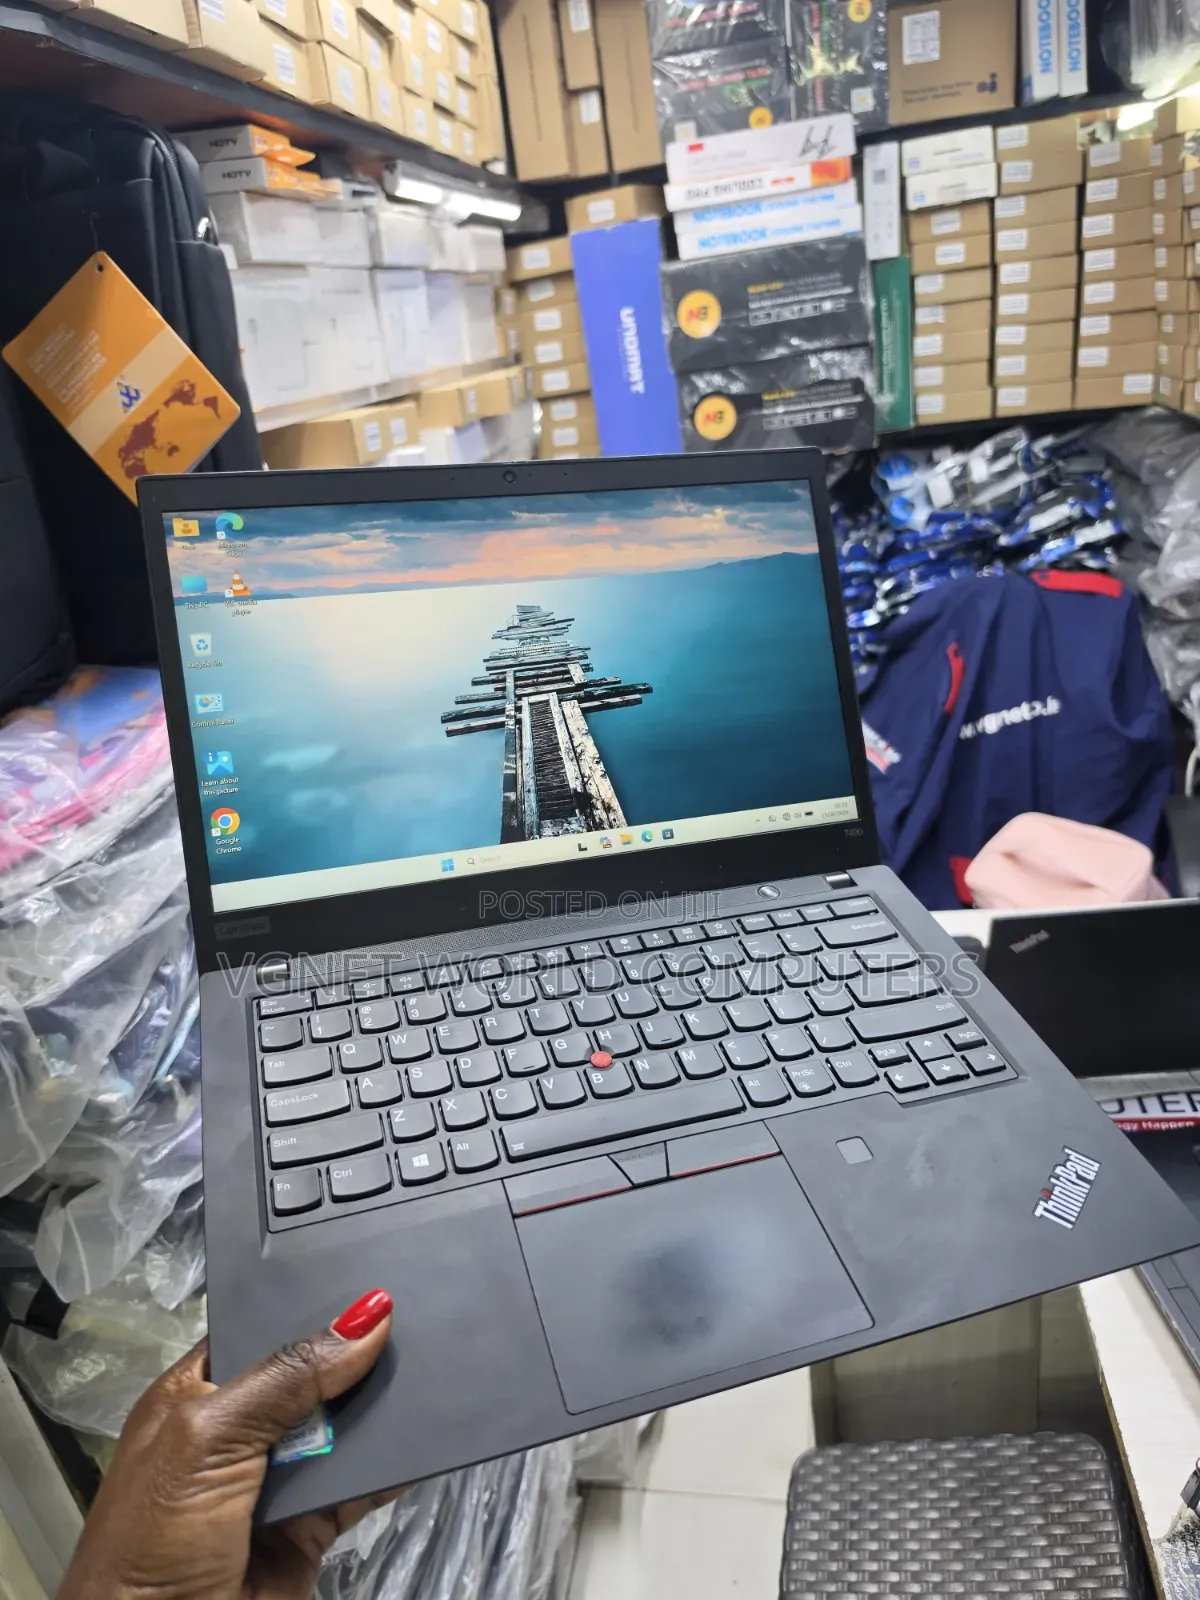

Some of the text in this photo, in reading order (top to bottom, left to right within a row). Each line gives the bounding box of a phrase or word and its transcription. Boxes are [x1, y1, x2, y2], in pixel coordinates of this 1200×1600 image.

[208, 138, 238, 148] HDTV
[221, 170, 251, 180] HDTV
[231, 609, 252, 617] player
[187, 660, 211, 669] Recycle
[191, 717, 235, 728] Control Panel
[201, 776, 240, 787] Learn about
[203, 786, 239, 796] this picture
[216, 836, 240, 845] Google
[216, 845, 242, 855] Chrome
[745, 916, 765, 924] Home
[778, 911, 792, 919] End
[630, 969, 640, 978] 8
[702, 977, 714, 987] O
[545, 984, 555, 993] 6
[502, 992, 511, 1001] 5
[618, 992, 630, 1002] U
[361, 1005, 372, 1014] @
[457, 1000, 466, 1009] 4
[575, 1000, 585, 1010] Y
[935, 1002, 955, 1012] Shift
[411, 1008, 420, 1018] 3
[530, 1008, 541, 1019] T
[729, 1006, 741, 1016] L
[364, 1017, 374, 1027] 2
[485, 1017, 498, 1028] R
[686, 1012, 700, 1023] K
[438, 1025, 450, 1036] E
[645, 1021, 654, 1032] J
[391, 1033, 407, 1045] W
[599, 1029, 612, 1041] H
[958, 1030, 978, 1039] PgDn
[343, 1043, 357, 1055] Q
[554, 1039, 568, 1050] G
[507, 1048, 518, 1060] F
[681, 1050, 697, 1061] M
[876, 1047, 897, 1057] PgUp
[268, 1060, 285, 1069] Tab
[459, 1057, 472, 1069] D
[636, 1059, 650, 1070] N
[835, 1059, 852, 1069] Ctrl
[411, 1067, 424, 1079] S
[591, 1072, 604, 1084] B
[791, 1068, 815, 1078] PrtSc
[362, 1077, 374, 1089] A
[542, 1077, 554, 1089] V
[748, 1079, 761, 1087] Alt
[495, 1088, 508, 1100] C
[270, 1092, 319, 1108] CapsLock
[445, 1098, 458, 1111] X
[394, 1109, 406, 1122] Z
[1141, 1120, 1195, 1131] Happen
[273, 1136, 298, 1148] Shift
[456, 1142, 470, 1152] Alt
[333, 1167, 353, 1179] Ctrl
[276, 1182, 291, 1191] Fn
[1032, 1145, 1102, 1231] ThinkPad
